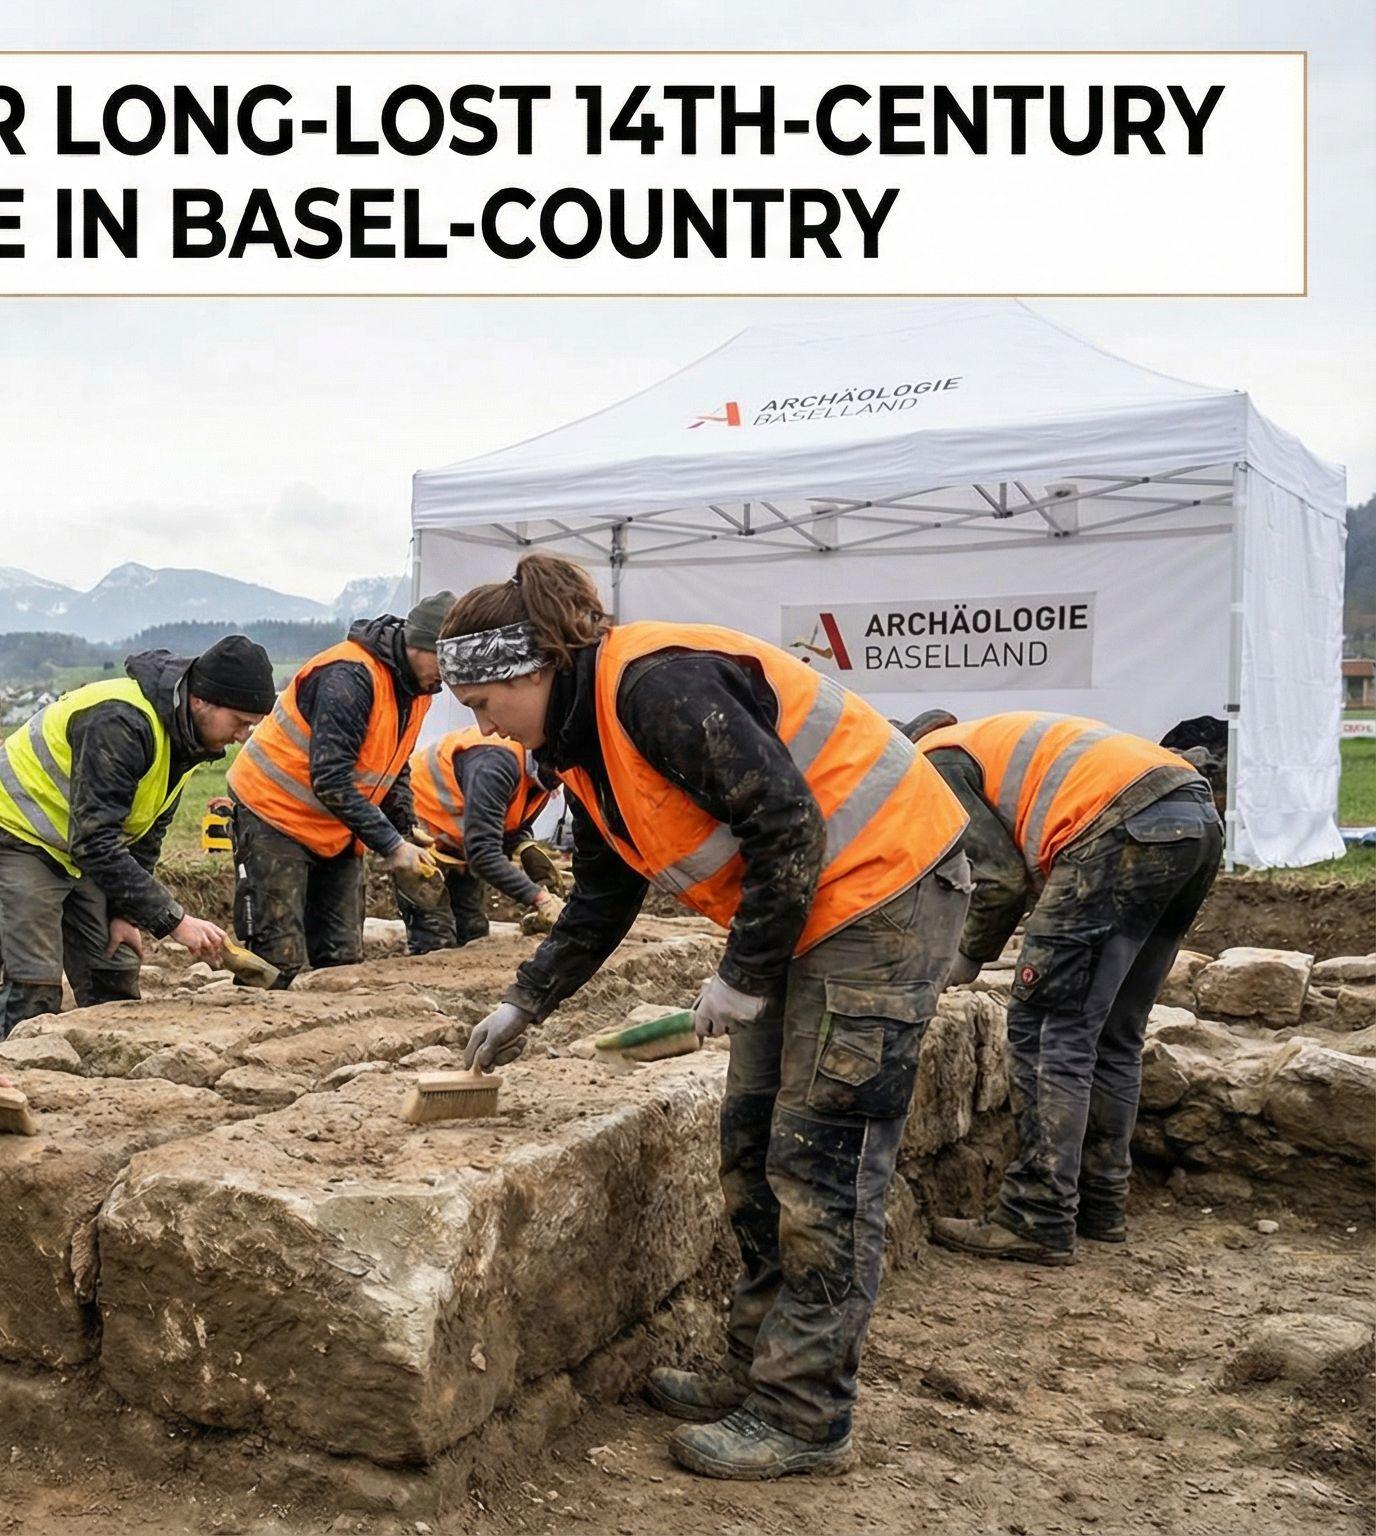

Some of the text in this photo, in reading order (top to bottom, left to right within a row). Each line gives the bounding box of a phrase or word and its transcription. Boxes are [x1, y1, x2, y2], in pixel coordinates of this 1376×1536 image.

[759, 376, 963, 412] ARCHÄOLOGIE
[752, 397, 918, 426] BASELLAND
[864, 603, 1089, 637] ARCHÄOLOGIE
[865, 640, 1048, 670] BASELLAND
